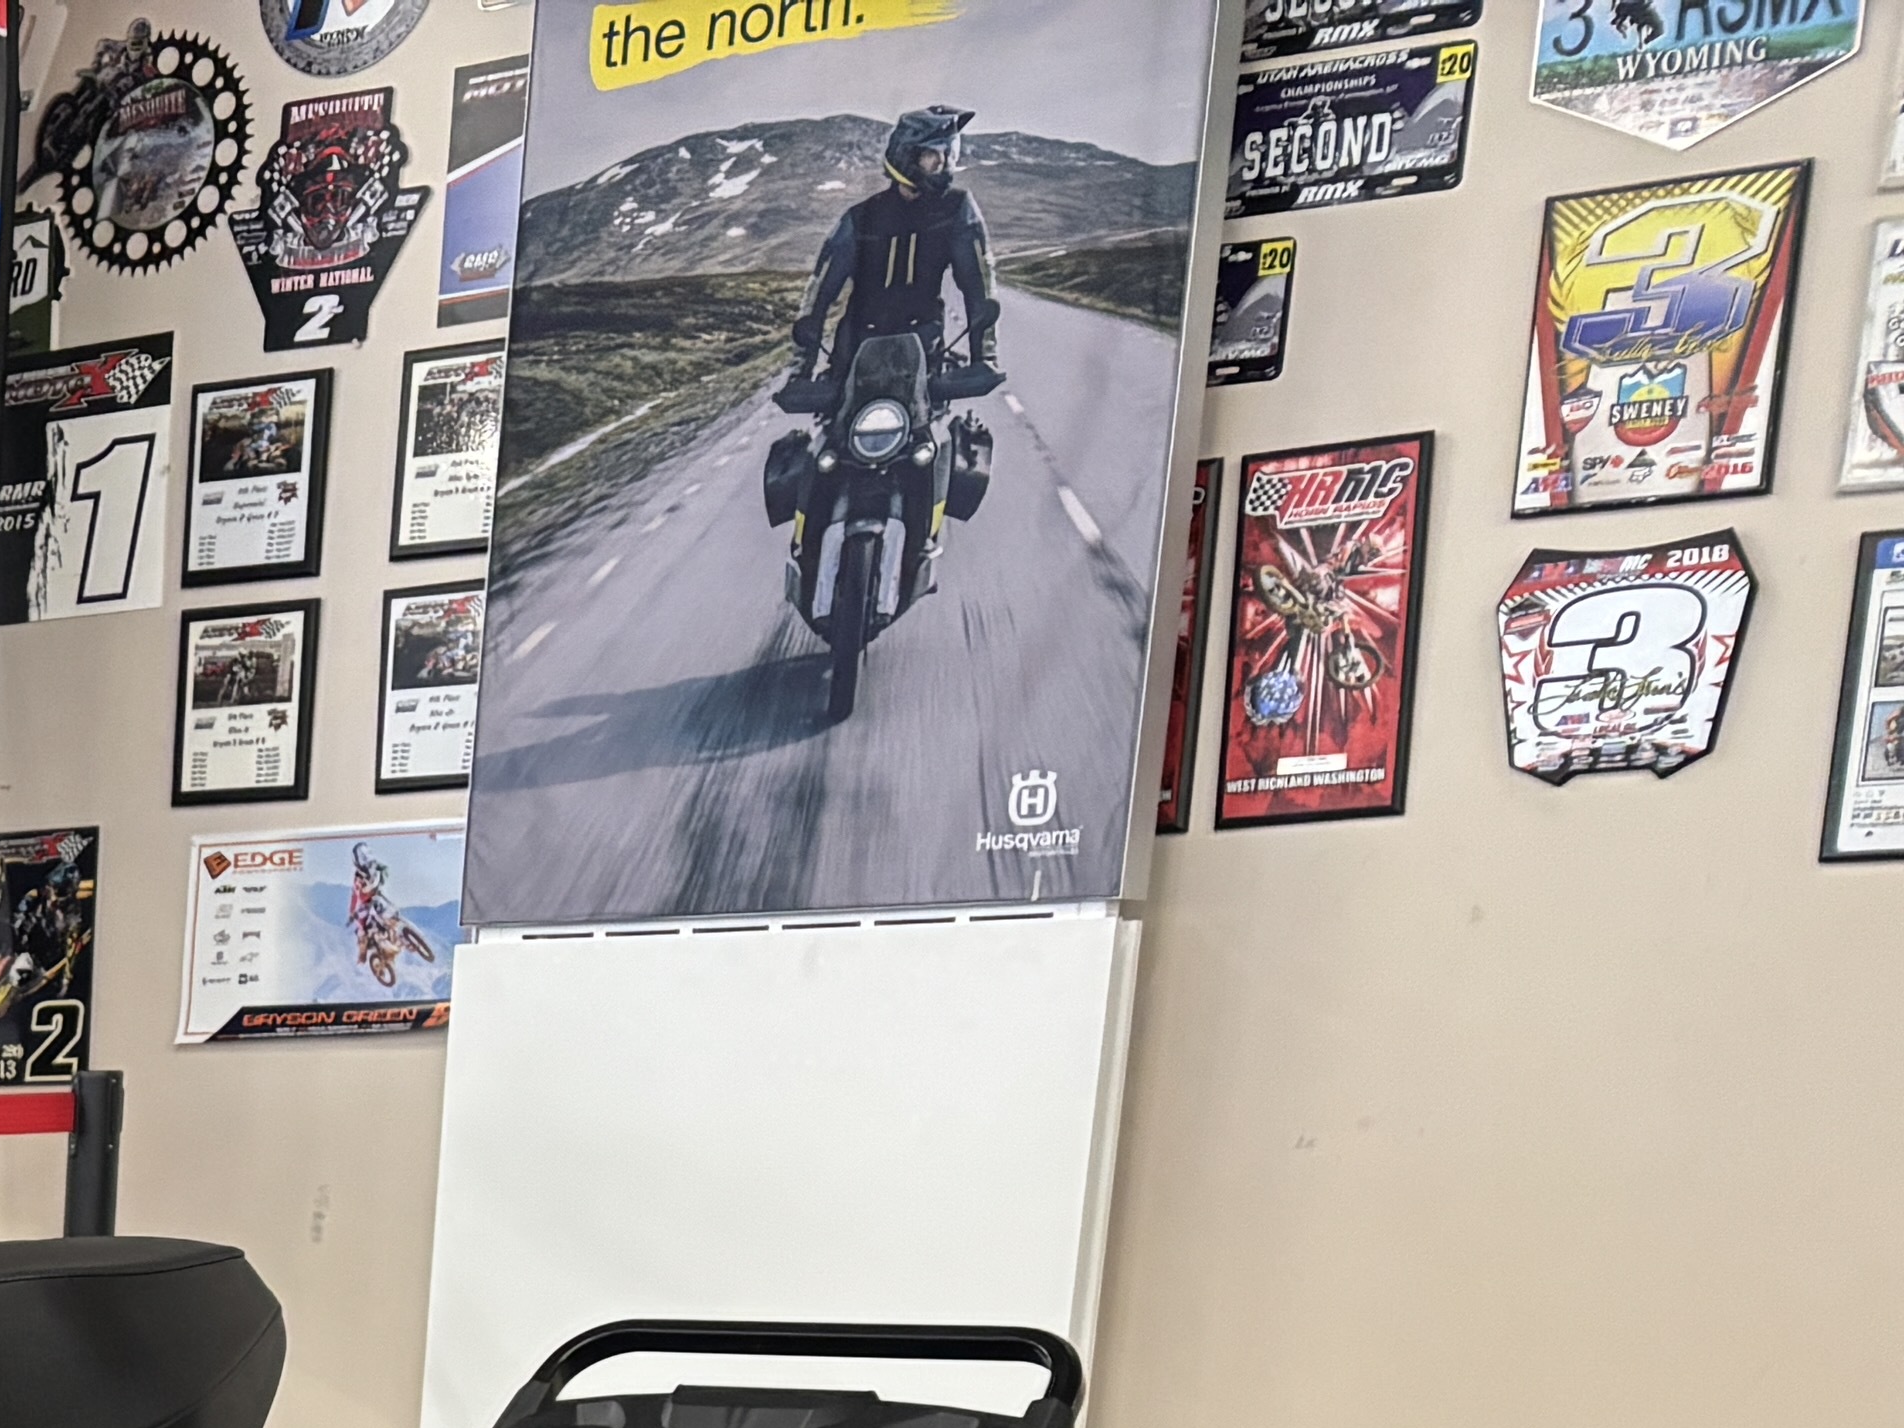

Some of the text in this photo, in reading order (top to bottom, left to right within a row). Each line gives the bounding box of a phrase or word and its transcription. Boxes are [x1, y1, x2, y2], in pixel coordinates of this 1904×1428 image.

[603, 15, 685, 67] the
[1313, 19, 1379, 46] RMX
[1618, 36, 1767, 80] WYOMING
[1281, 75, 1376, 98] CHAMPIONSHIPS
[1242, 113, 1392, 181] SECOND
[1296, 179, 1365, 203] RMX
[271, 267, 374, 293] WINTER NATIONAL
[1561, 192, 1779, 366] 3
[294, 294, 343, 341] 2
[1612, 400, 1686, 422] SWENEY
[71, 432, 156, 604] 1
[1667, 544, 1730, 568] 2018
[1533, 582, 1708, 739] 3
[1227, 768, 1385, 793] WEST RICHLAND WASHINGTON
[976, 828, 1081, 852] Husqvarna
[233, 848, 303, 869] EDGE
[342, 1007, 417, 1024] GREEN
[25, 1000, 84, 1082] 2
